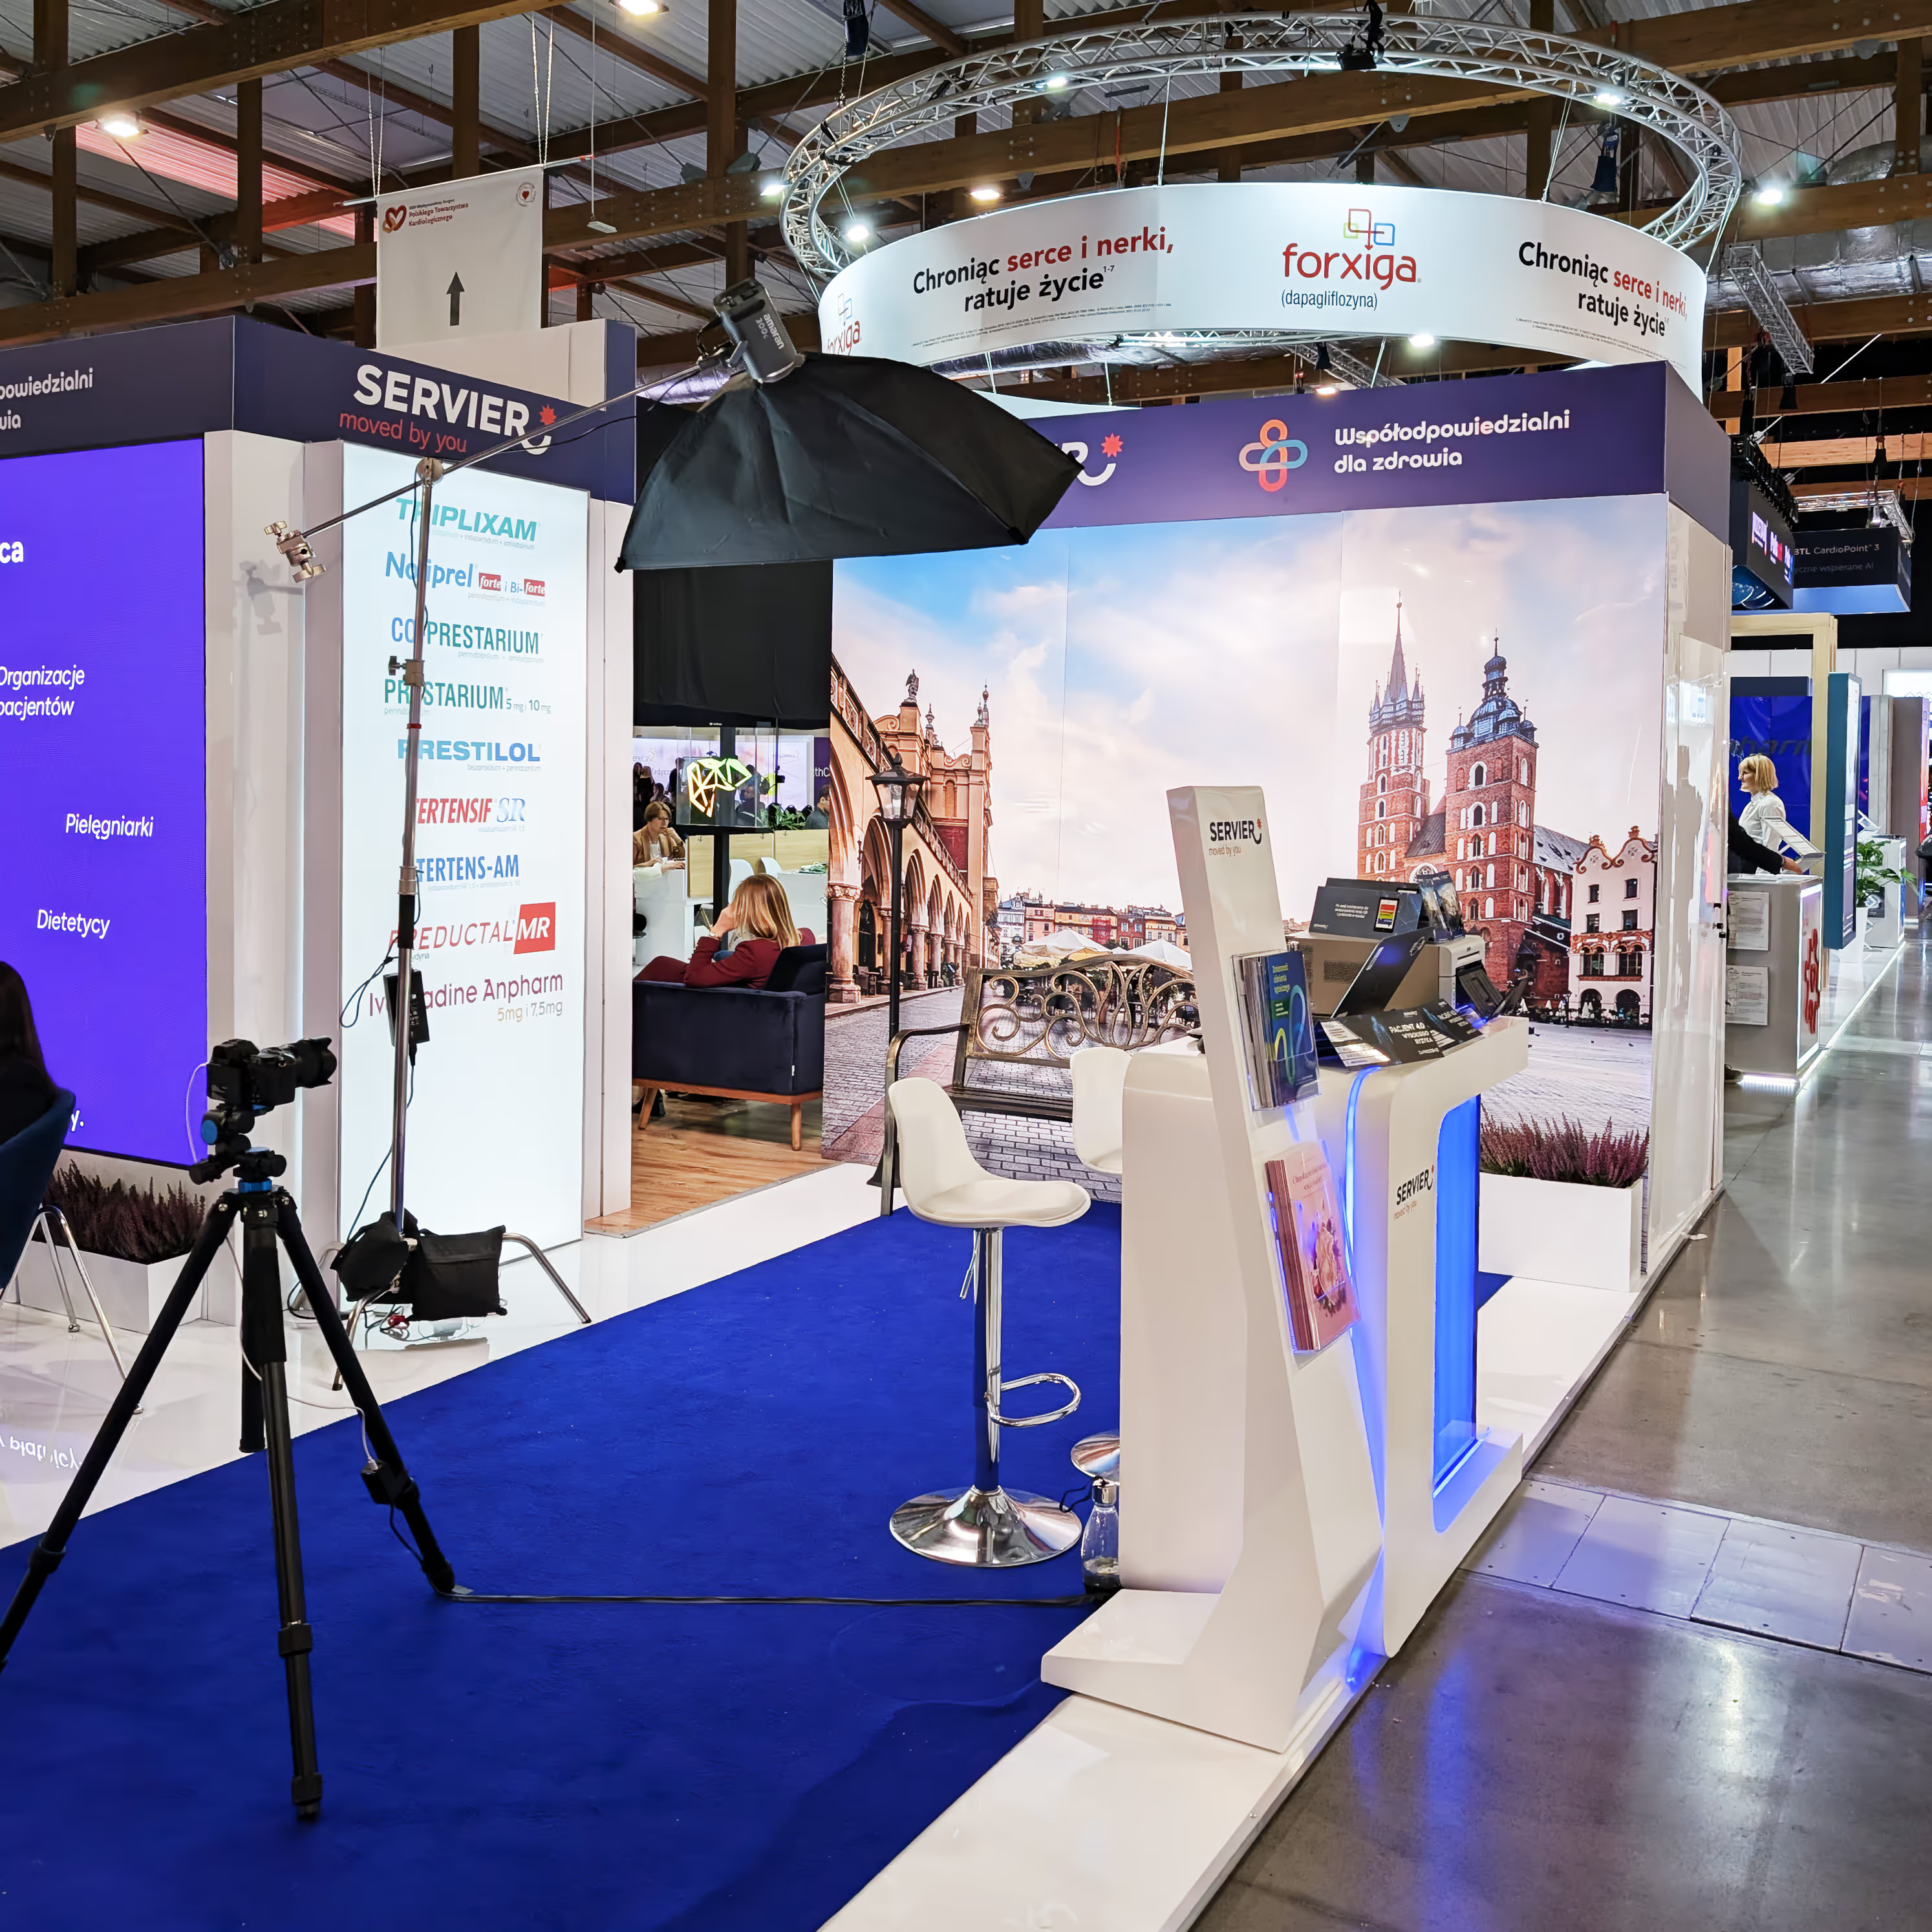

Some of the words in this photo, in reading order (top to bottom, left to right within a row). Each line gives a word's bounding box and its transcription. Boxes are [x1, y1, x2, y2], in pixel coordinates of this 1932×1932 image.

[409, 209, 434, 218] Polskiego
[435, 203, 469, 213] Towarzystwa
[409, 215, 453, 227] Kardiologicznego
[913, 257, 1000, 294] Chroniąc
[1007, 243, 1072, 272] serce
[1081, 235, 1088, 259] i
[1097, 226, 1174, 256] nerki,
[965, 280, 1031, 312] ratuje
[1519, 242, 1609, 288] Chroniąc
[1614, 270, 1652, 299] serce
[1656, 280, 1660, 303] i
[1662, 291, 1687, 321] nerki,
[1282, 290, 1378, 311] (dapagliflozyna)
[1578, 293, 1629, 326] ratuje
[763, 313, 784, 349] amaran
[354, 365, 552, 455] SERVIER
[339, 413, 403, 440] moved
[409, 422, 431, 449] by
[435, 433, 467, 453] you
[1335, 409, 1570, 447] Współodpowiedzialni
[1335, 455, 1367, 473] dla
[1373, 447, 1463, 471] zdrowia
[385, 552, 474, 588] Noiprel
[479, 574, 502, 590] forte
[385, 679, 504, 710] PRSTARIUM
[506, 698, 512, 710] 5
[528, 700, 540, 711] 10
[65, 813, 154, 840] Pielęgniarki
[415, 798, 492, 824] ERTENSIF
[497, 797, 526, 822] SR
[1210, 821, 1262, 845] SERVIER
[1208, 844, 1225, 855] moved
[1226, 844, 1232, 857] by
[1233, 846, 1241, 856] you
[37, 909, 110, 939] Dietetycy
[388, 920, 514, 951] PEDUCTAL
[517, 916, 550, 941] MR
[369, 983, 477, 1017] Ivadine
[483, 974, 563, 1004] Anpharm
[497, 1007, 523, 1022] 5mg
[531, 1001, 563, 1017] 7,5mg
[1397, 1169, 1433, 1206] SERVIER
